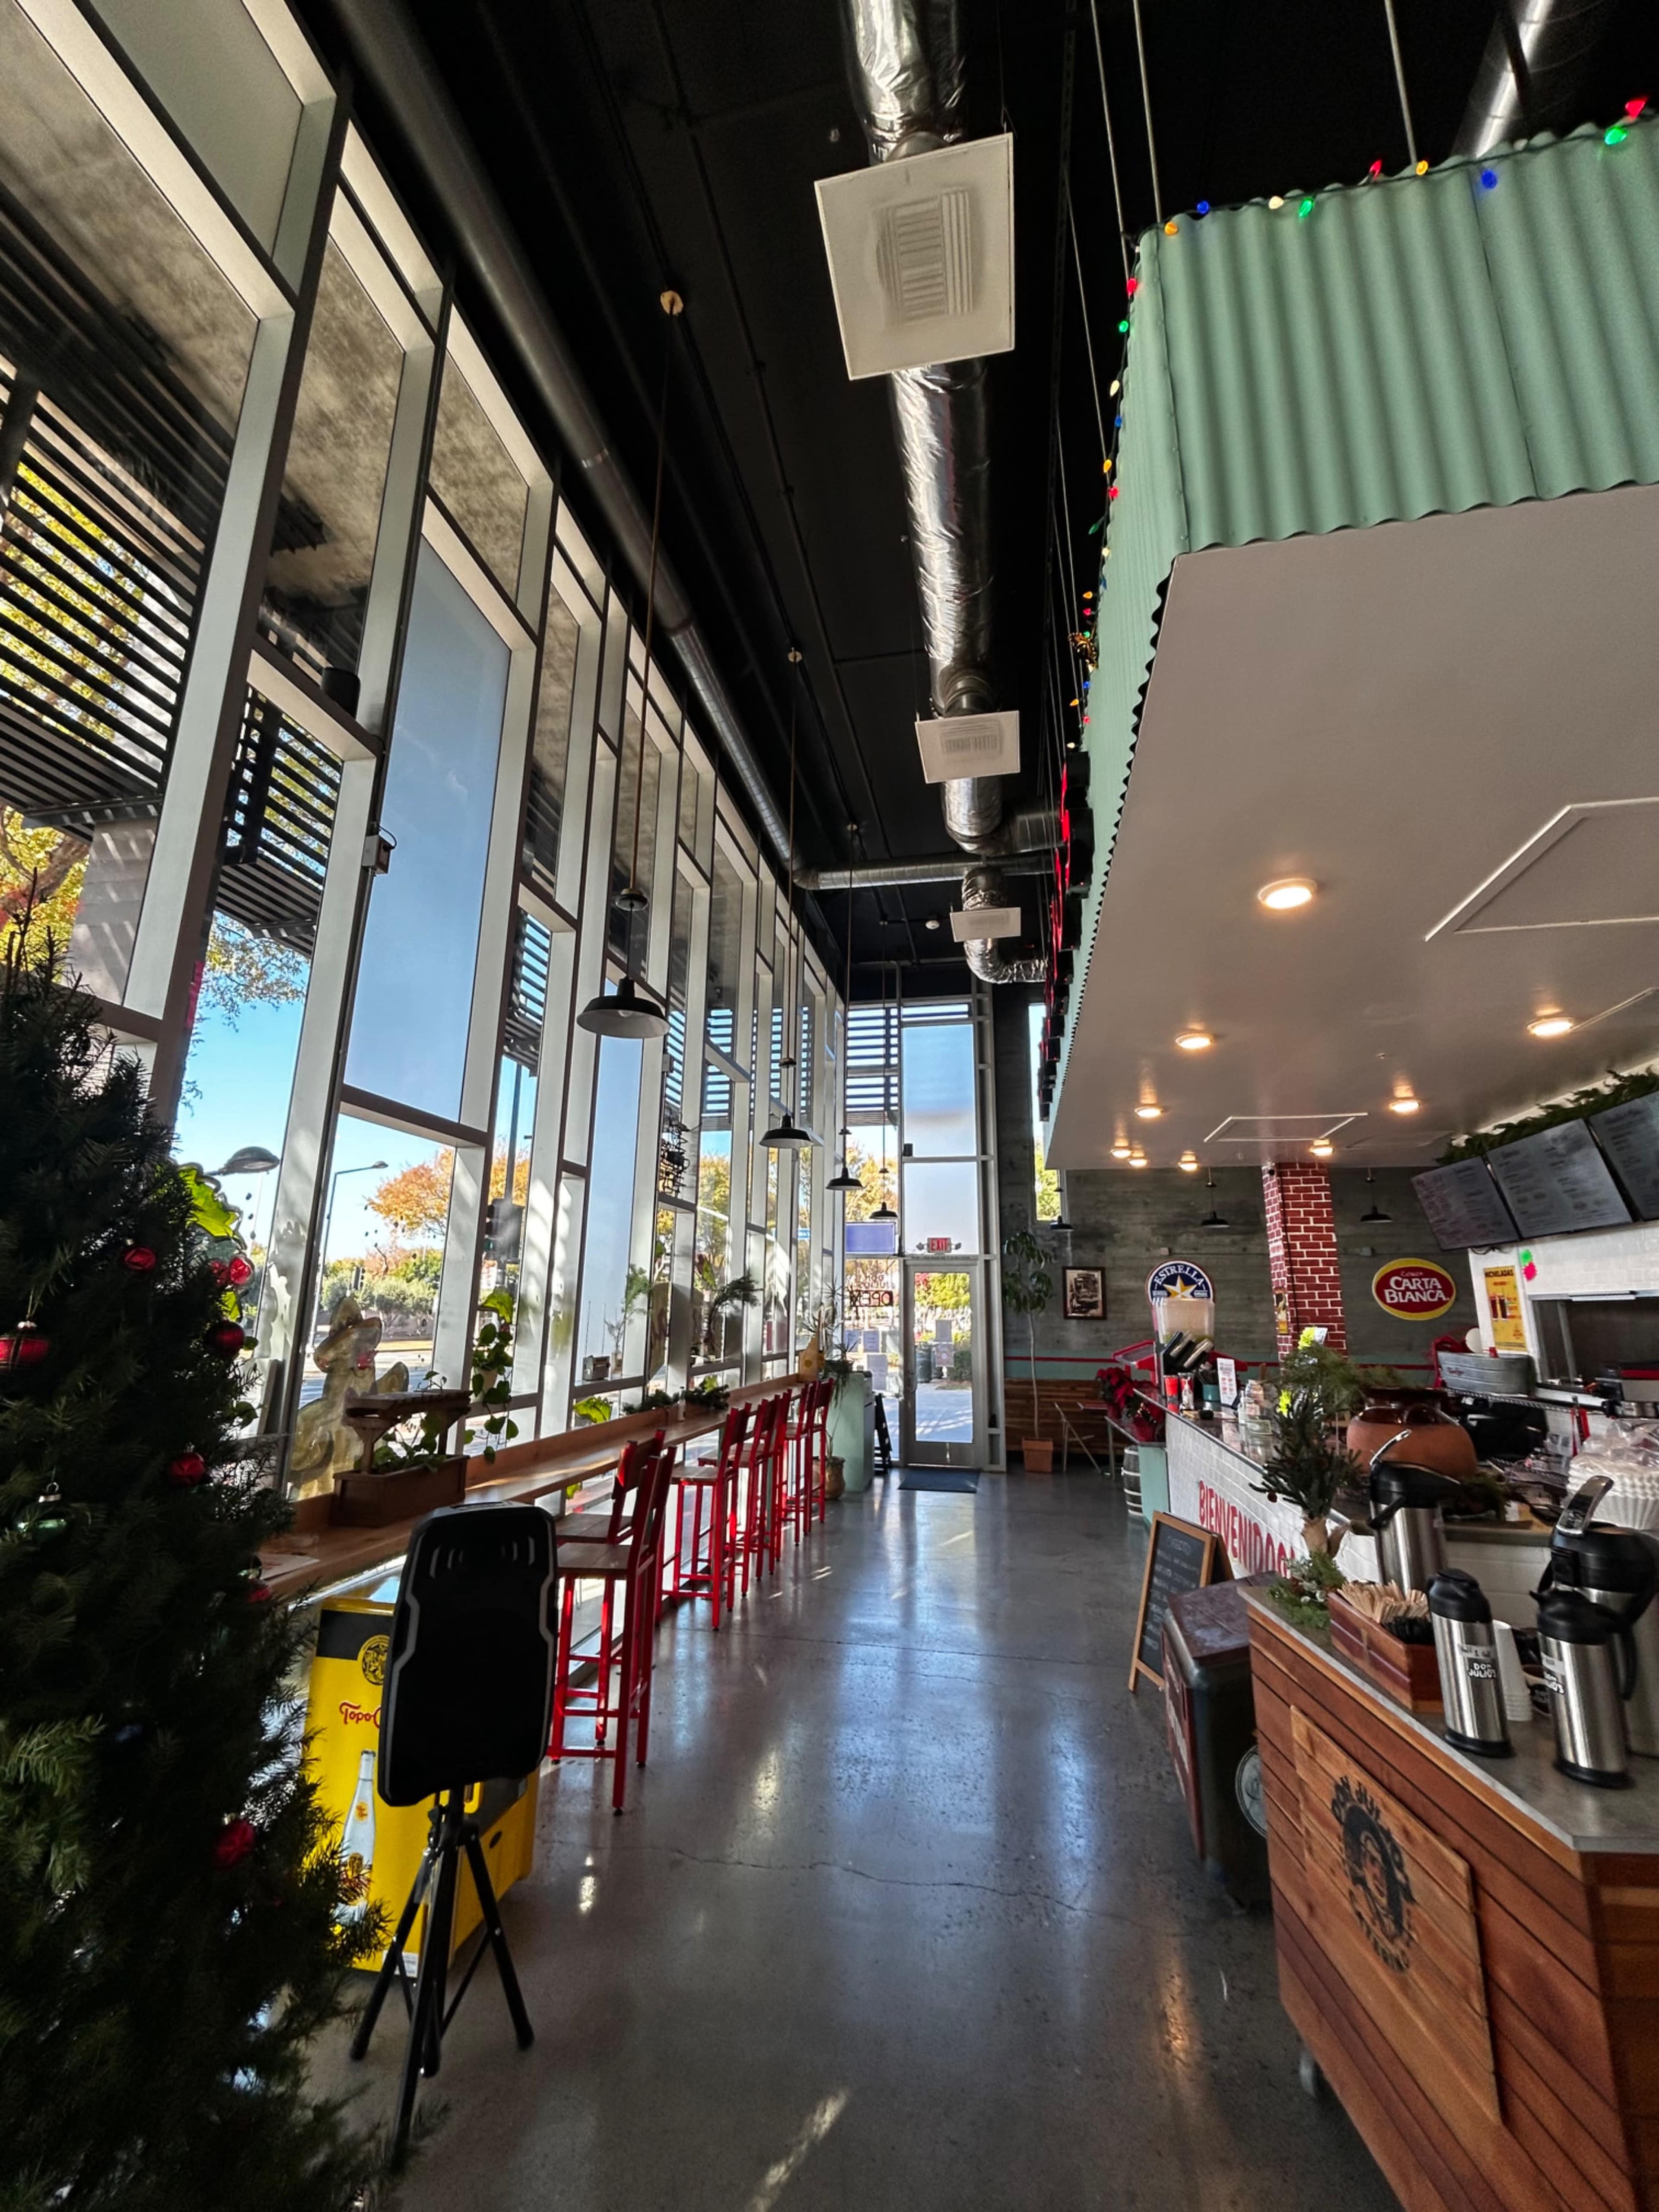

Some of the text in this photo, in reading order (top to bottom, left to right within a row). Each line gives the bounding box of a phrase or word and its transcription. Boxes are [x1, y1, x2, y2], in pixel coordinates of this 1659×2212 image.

[931, 1238, 948, 1251] EXIT
[1154, 1265, 1205, 1286] ESTRELLA
[1389, 1276, 1442, 1290] CARTA
[1384, 1289, 1448, 1303] BLANCA
[340, 1701, 371, 1725] Topo
